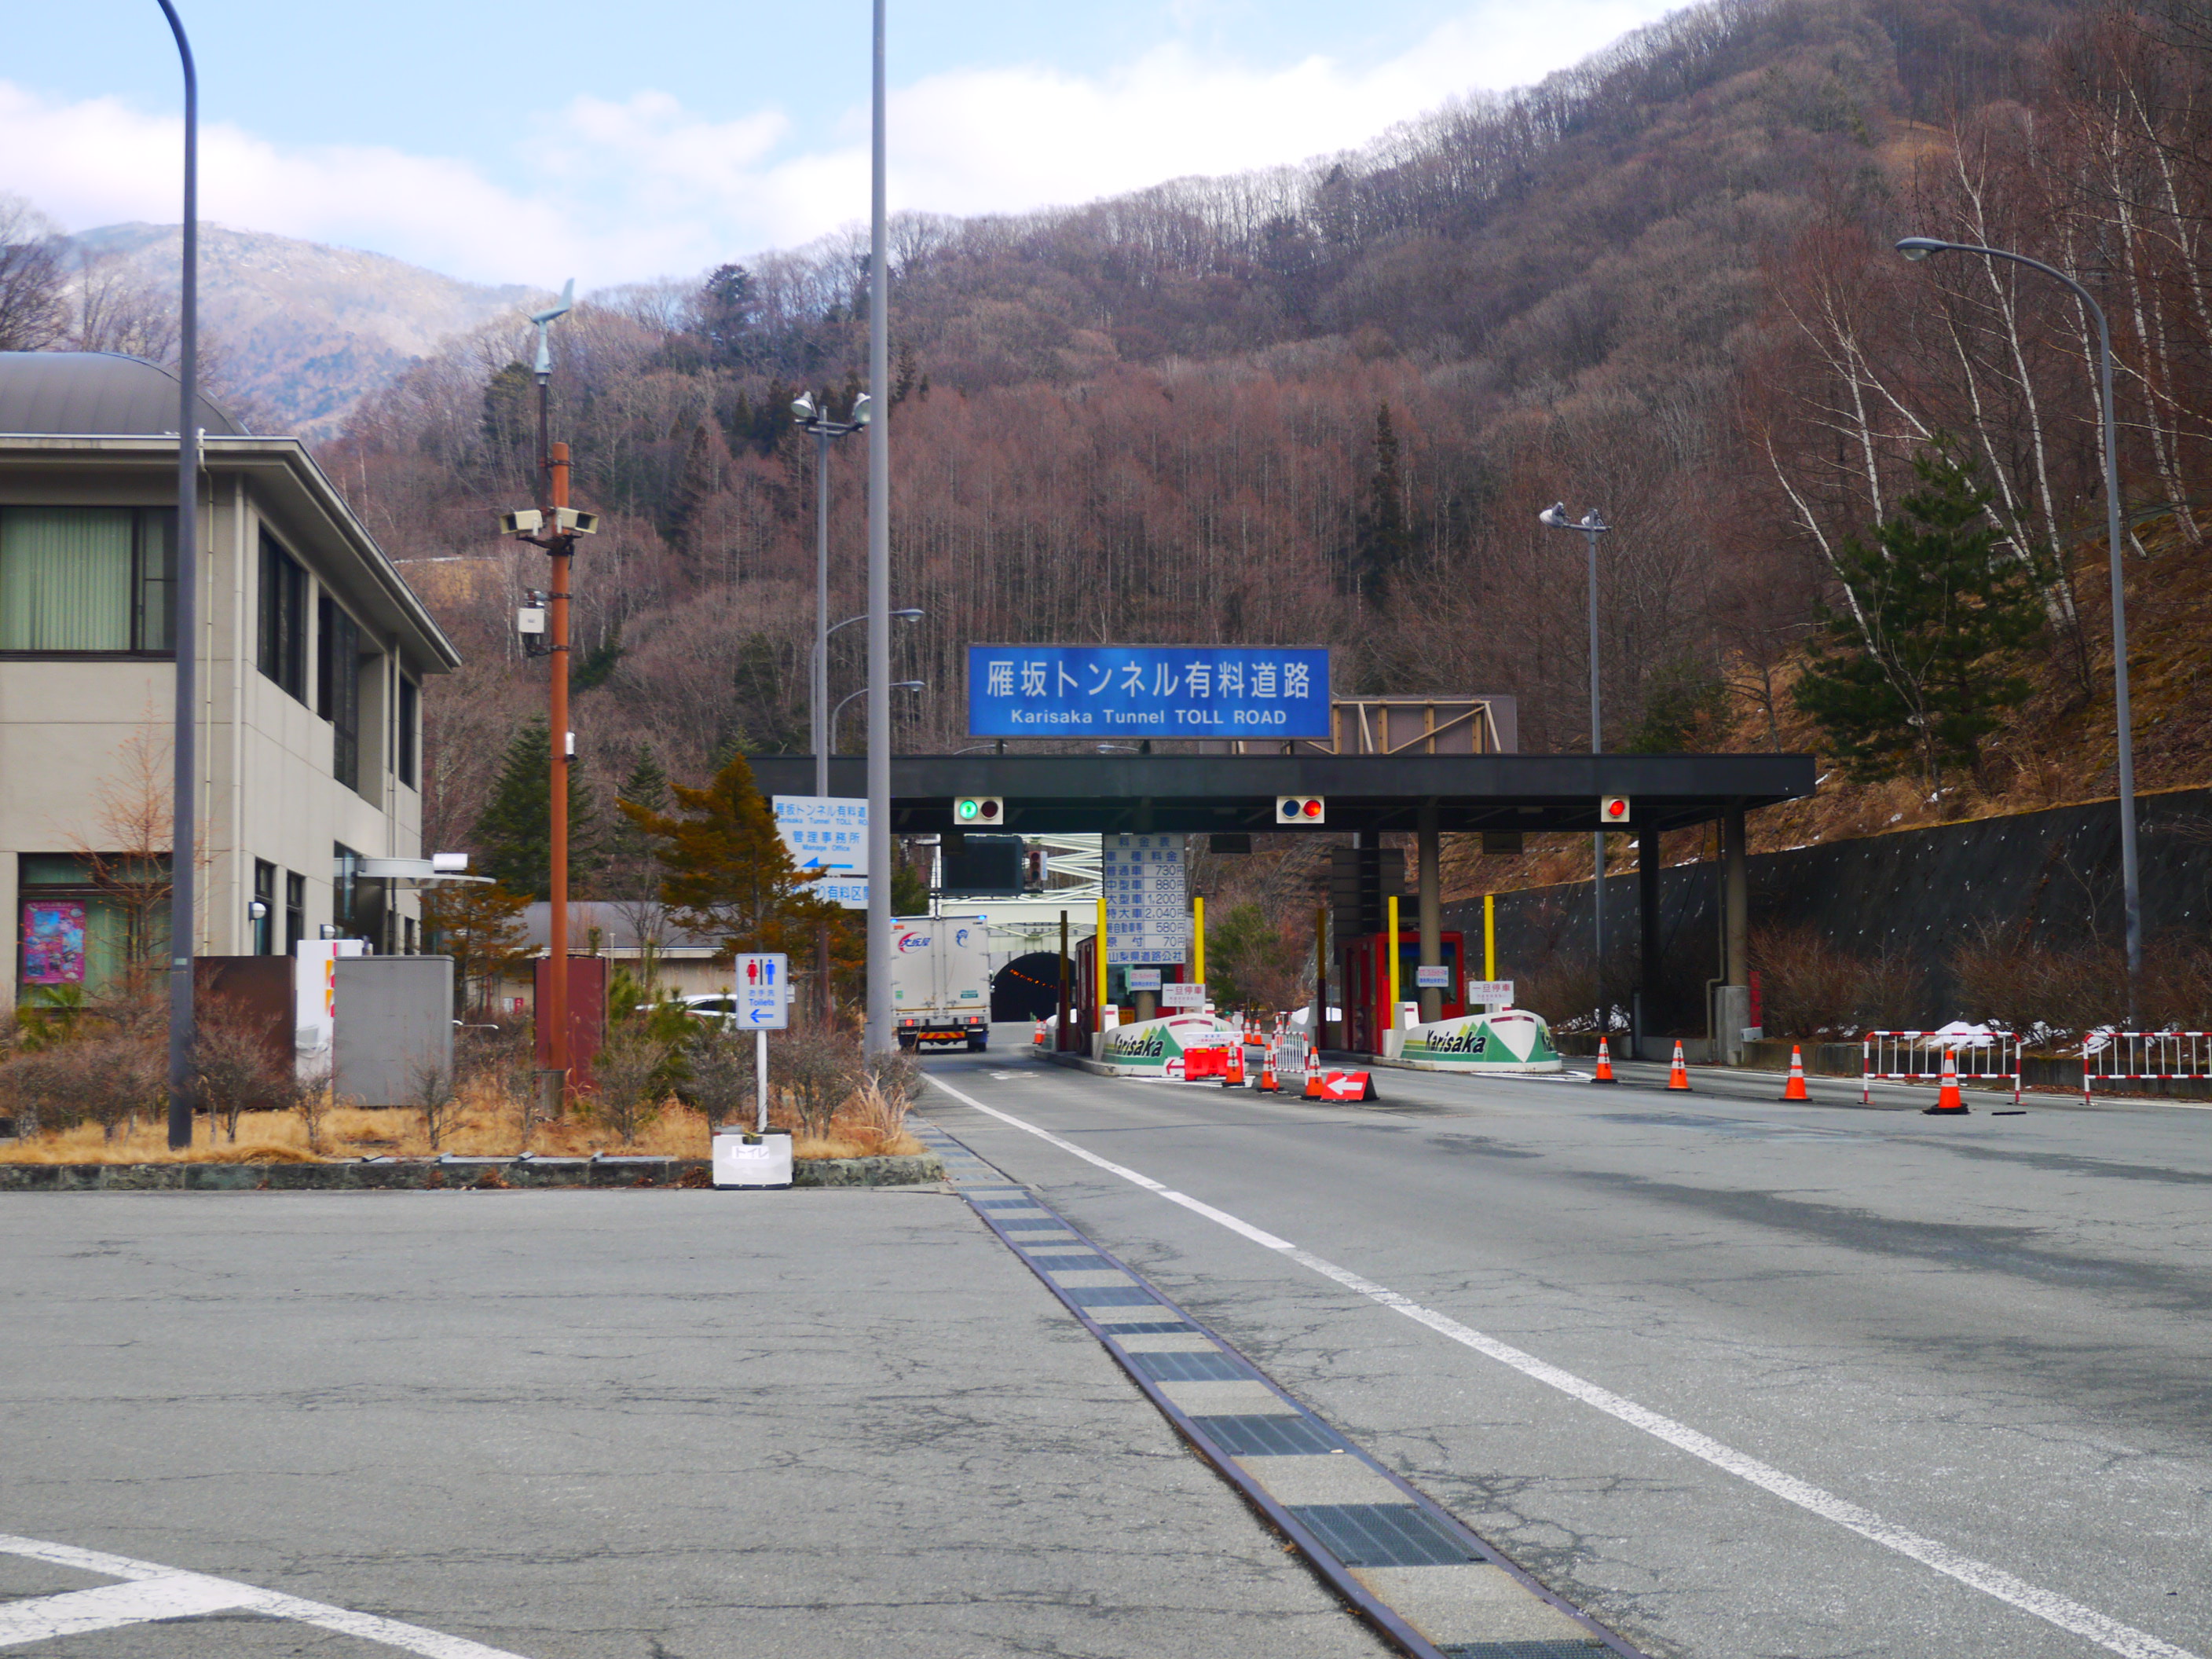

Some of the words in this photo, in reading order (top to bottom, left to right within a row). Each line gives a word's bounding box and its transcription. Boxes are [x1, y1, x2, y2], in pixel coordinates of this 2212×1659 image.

[987, 661, 1310, 699] 雁坂トンネル有料道路
[1012, 709, 1093, 724] Karisaka
[1104, 709, 1164, 724] Tunnel
[1175, 710, 1224, 724] TOLL
[1234, 710, 1287, 725] ROAD
[776, 803, 866, 818] 雁坂トンネル有料道
[793, 830, 860, 844] 管理事務所
[1152, 851, 1177, 862] 料金
[1155, 865, 1185, 876] 730円
[1106, 880, 1142, 890] 中型車
[1155, 879, 1185, 890] 880円
[1106, 894, 1142, 905] 大型車
[1107, 908, 1142, 919] 特大車
[1145, 908, 1185, 919] 2,040円
[1155, 922, 1185, 933] 580円
[1163, 937, 1185, 947] 70円
[1108, 951, 1182, 962] 山梨県道路公社
[1166, 986, 1202, 994] 一旦停車
[1472, 983, 1511, 992] 一旦停車
[1115, 1033, 1163, 1057] Karisaka
[1426, 1030, 1486, 1053] Karisaka
[736, 1148, 768, 1158] トイレ
